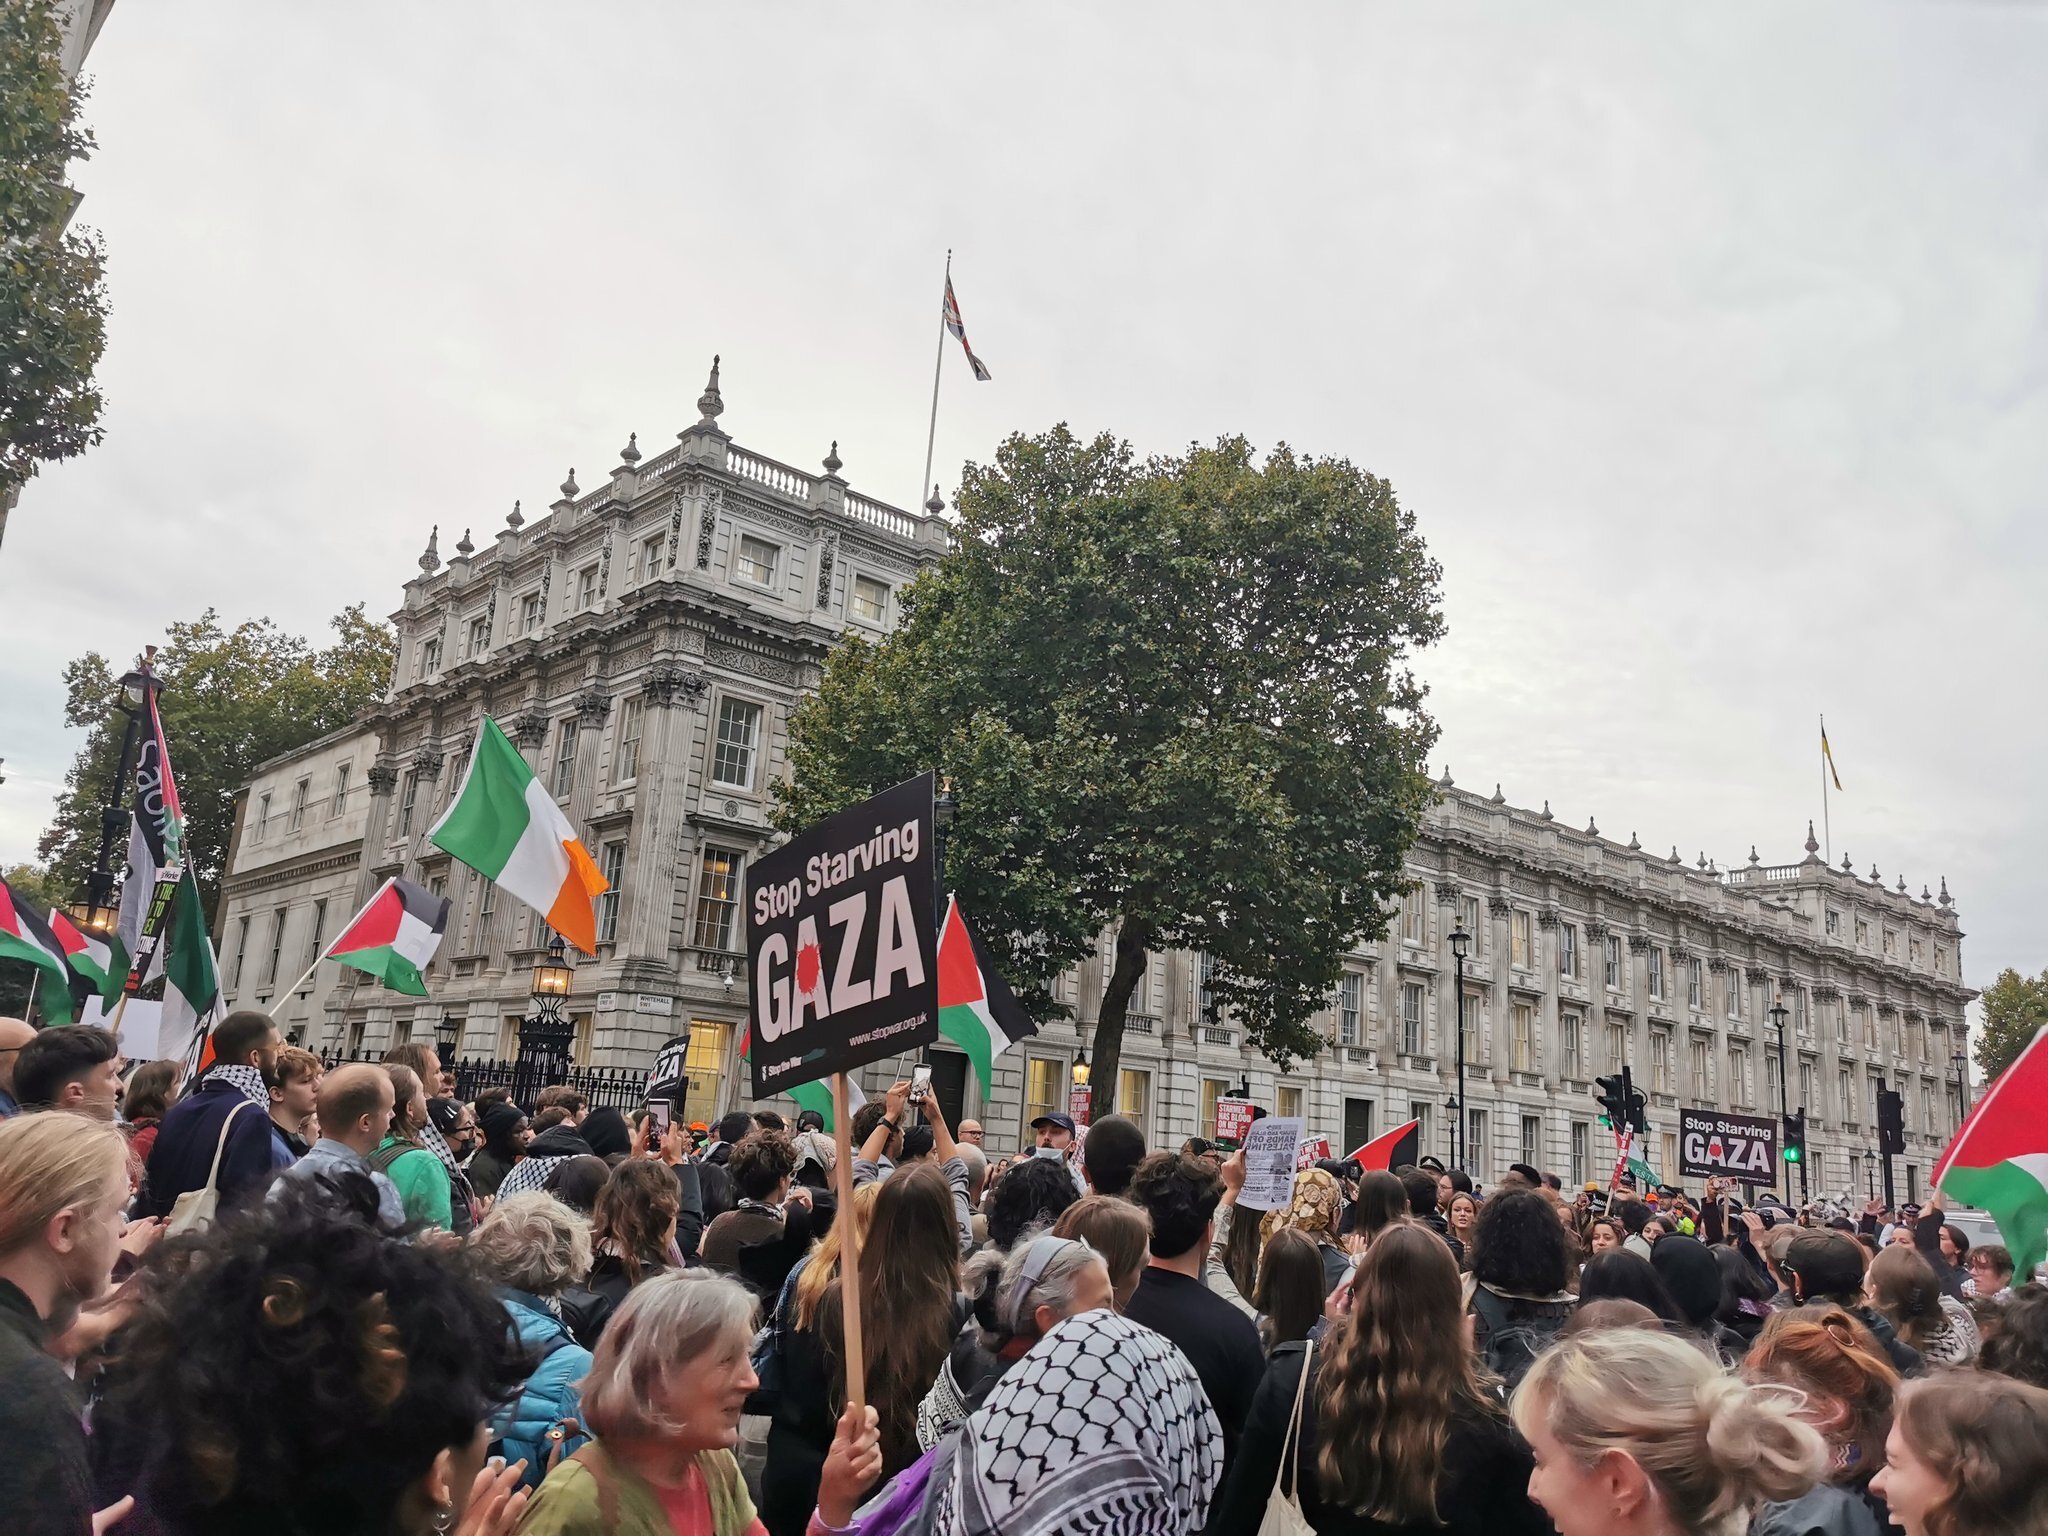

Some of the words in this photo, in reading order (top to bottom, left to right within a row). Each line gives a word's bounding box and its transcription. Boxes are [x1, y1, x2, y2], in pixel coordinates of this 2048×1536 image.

[754, 877, 801, 926] Stop
[806, 818, 919, 897] Starving
[757, 875, 926, 1043] GAZA
[640, 996, 670, 1004] WHITEHALL
[849, 1011, 928, 1047] www.stopwar.org.uk
[1218, 1112, 1230, 1121] HAS
[1230, 1113, 1252, 1123] BLOOD
[1219, 1104, 1246, 1115] STARMER
[1217, 1128, 1237, 1138] HANDS
[1218, 1120, 1226, 1129] ON
[1227, 1121, 1238, 1130] HIS
[1685, 1117, 1713, 1133] Stop
[1716, 1120, 1772, 1141] Starving
[1684, 1132, 1771, 1173] GAZA
